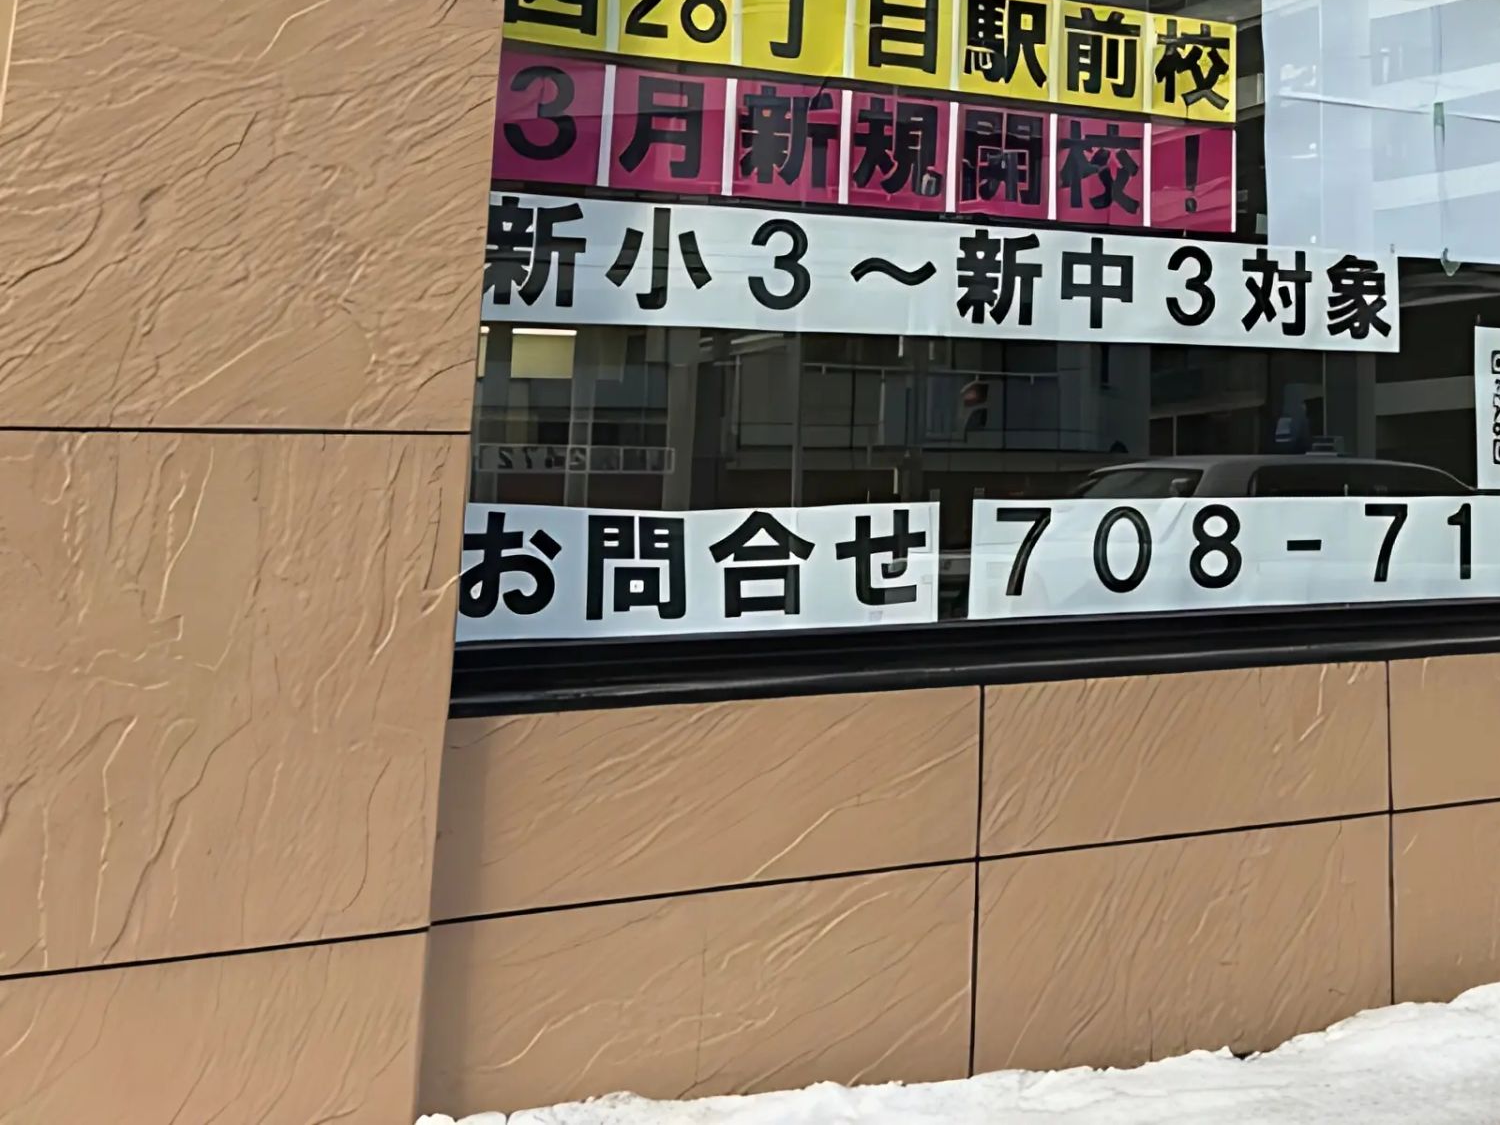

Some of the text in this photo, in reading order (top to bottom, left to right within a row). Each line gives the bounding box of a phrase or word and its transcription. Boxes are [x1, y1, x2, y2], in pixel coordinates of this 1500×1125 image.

[503, 66, 1199, 213] 3月新規開校！
[483, 195, 1393, 340] 新小3～新中3対象
[458, 509, 926, 620] お問合せ
